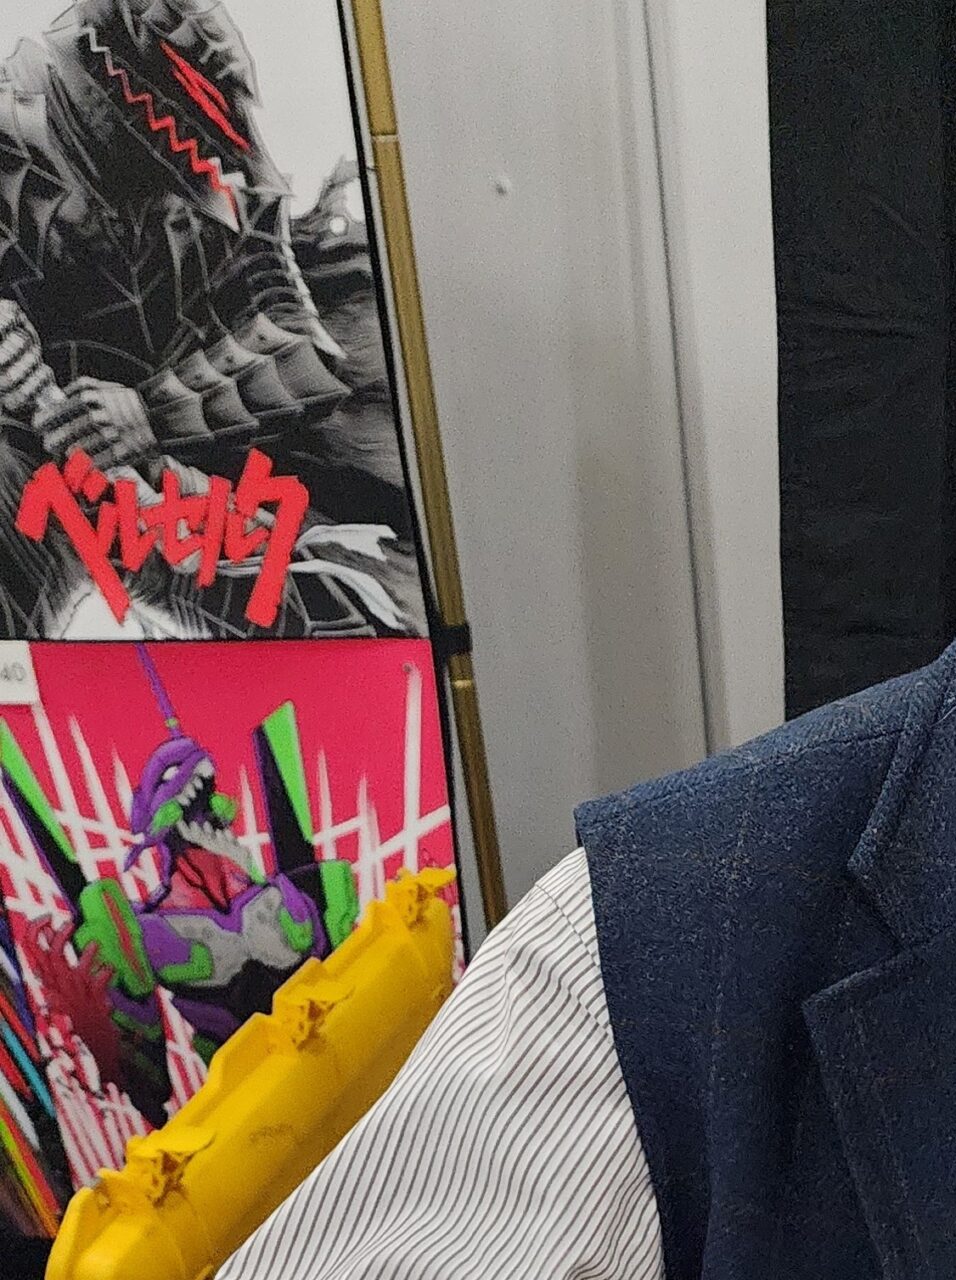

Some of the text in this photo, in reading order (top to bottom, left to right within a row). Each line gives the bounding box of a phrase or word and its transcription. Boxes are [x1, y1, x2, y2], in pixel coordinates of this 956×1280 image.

[15, 447, 310, 628] ベルセルク
